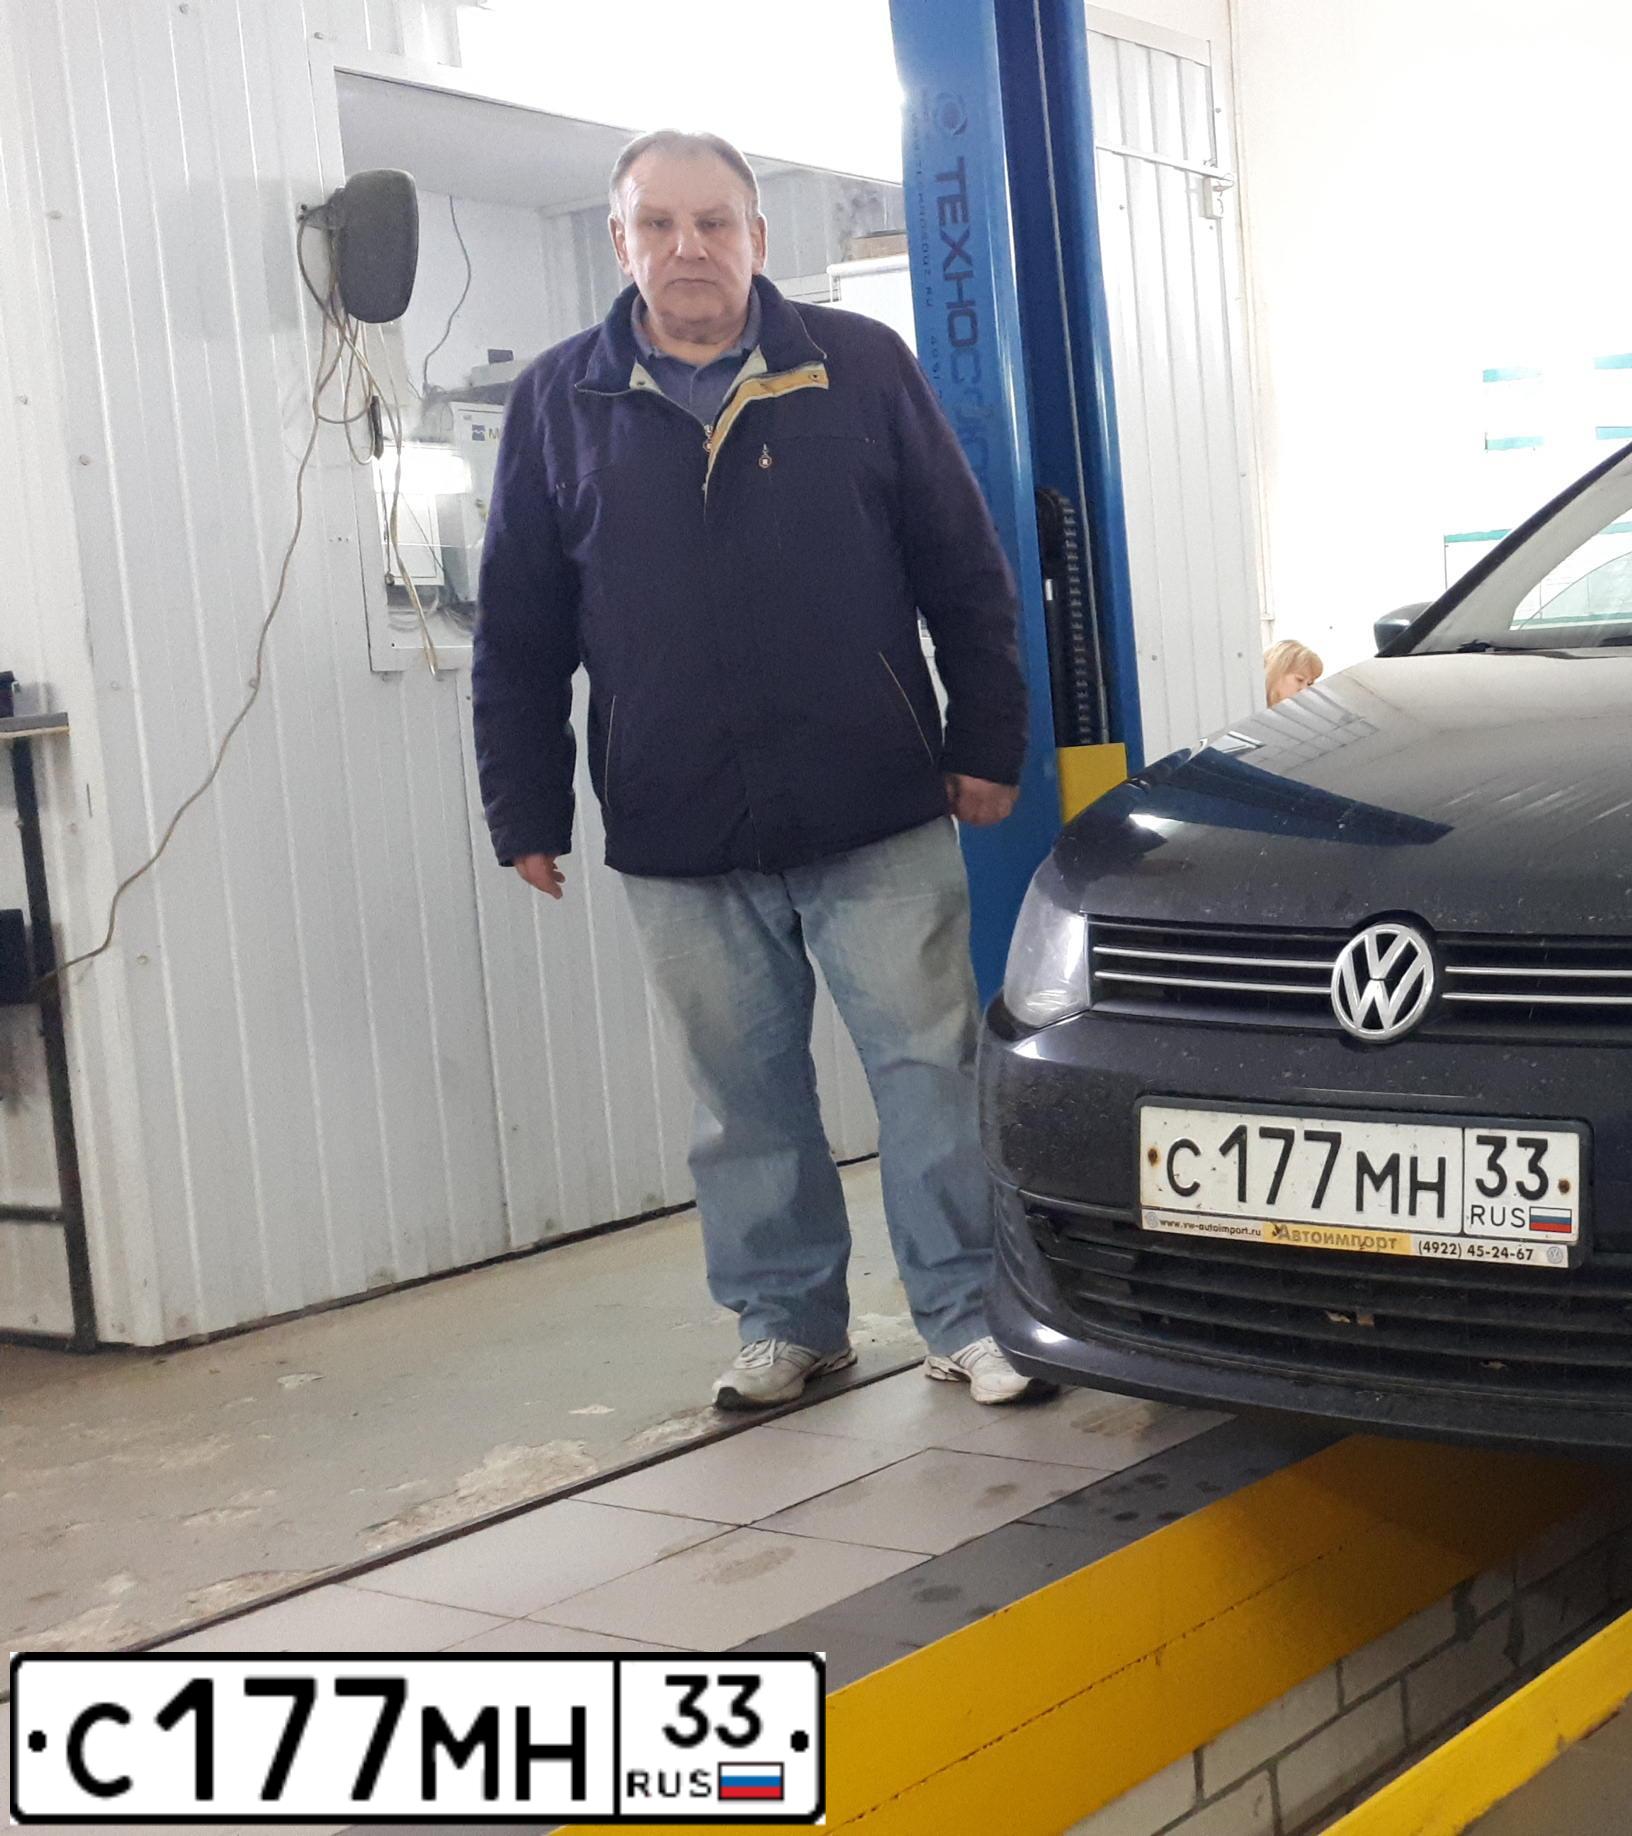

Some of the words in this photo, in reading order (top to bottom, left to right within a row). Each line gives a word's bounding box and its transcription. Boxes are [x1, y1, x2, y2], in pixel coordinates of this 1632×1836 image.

[1165, 1124, 1447, 1219] С177МН
[1474, 1134, 1550, 1201] 33
[1159, 1218, 1262, 1238] www.vw-autoimport.ru
[1469, 1204, 1527, 1230] RUS
[1417, 1240, 1463, 1259] (4922)
[1466, 1244, 1534, 1262] 45-24-67
